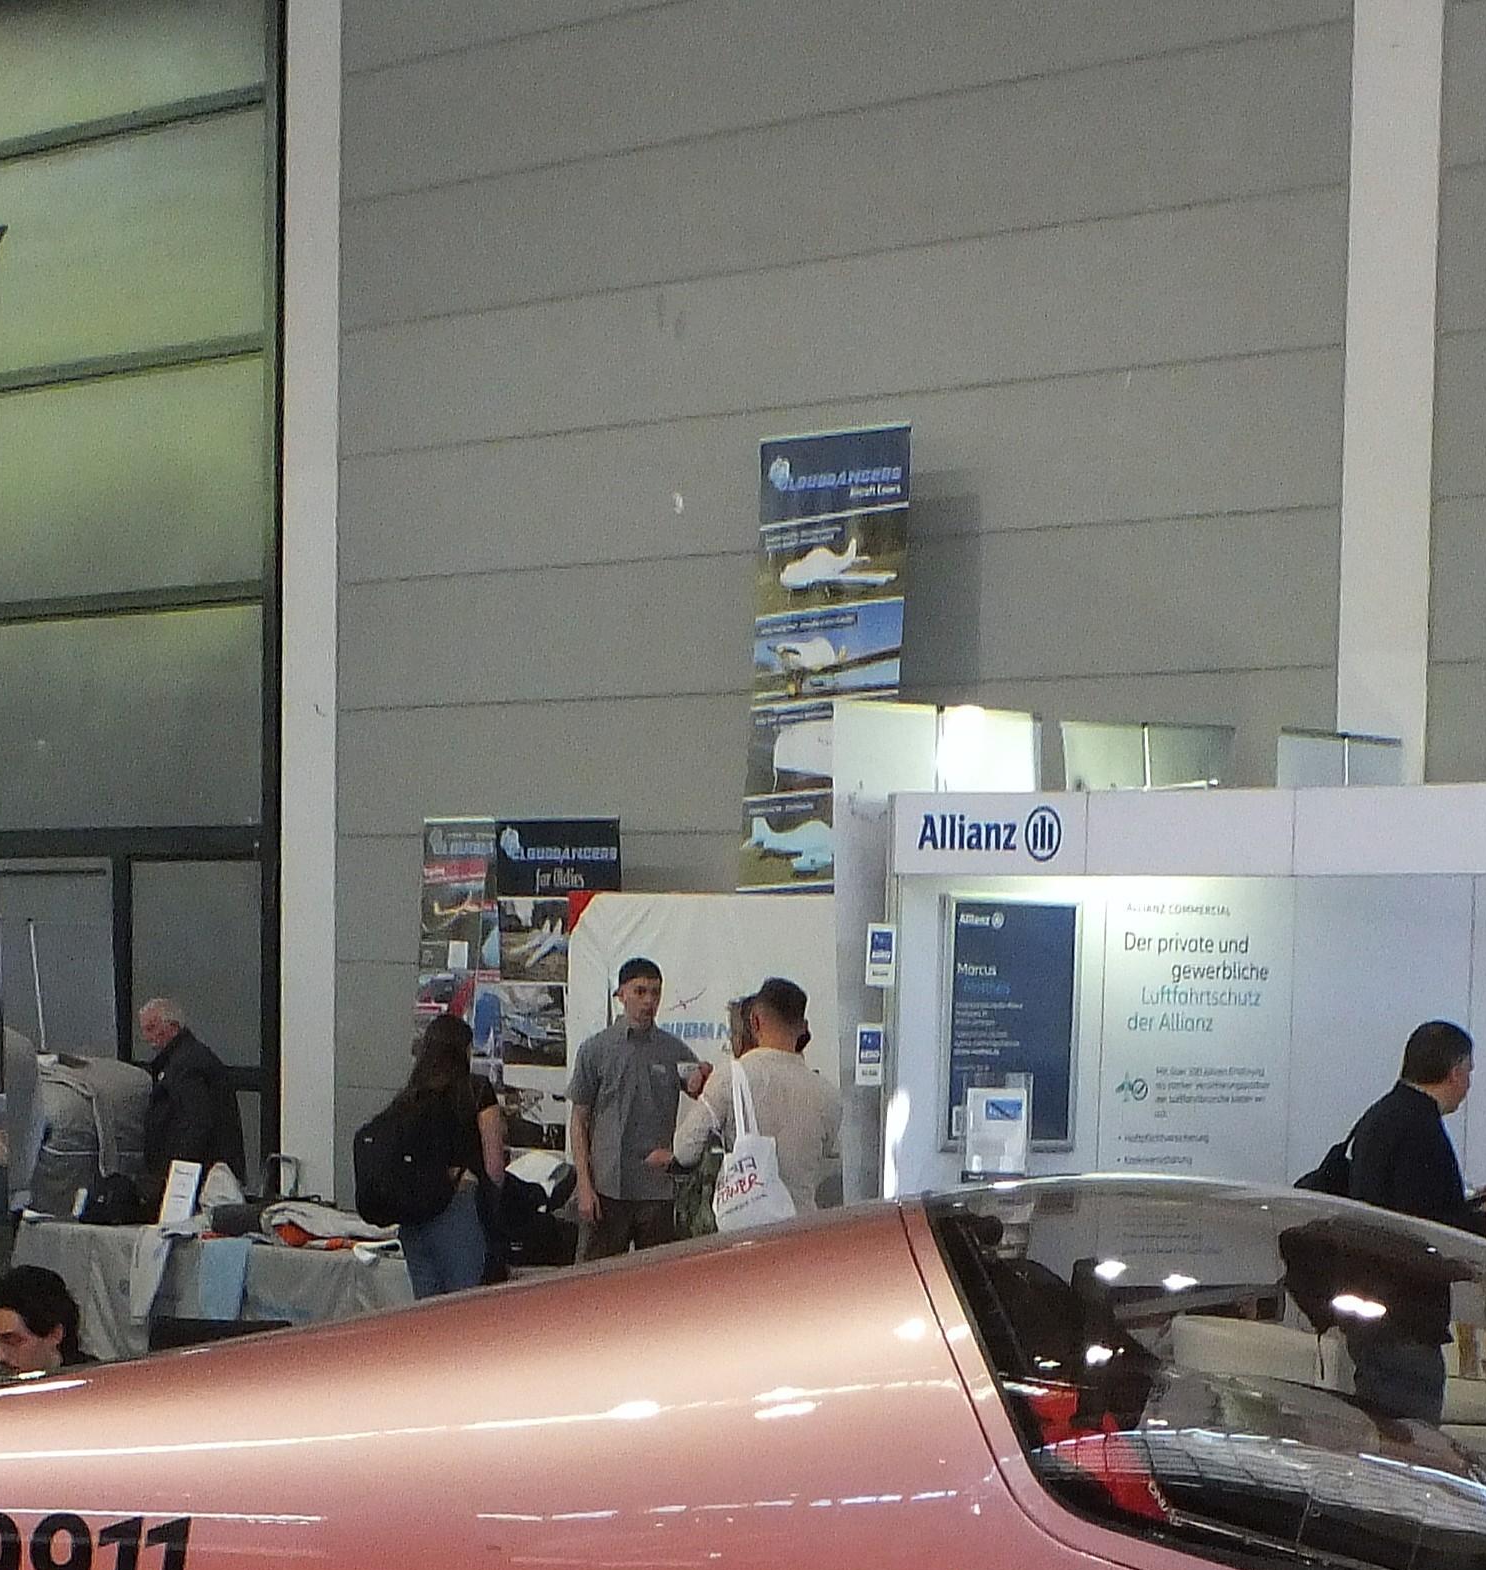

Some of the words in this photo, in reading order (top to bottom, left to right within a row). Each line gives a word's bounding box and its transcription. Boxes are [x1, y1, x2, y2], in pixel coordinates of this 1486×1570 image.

[918, 813, 1017, 851] Allianz
[1124, 931, 1153, 951] Der
[1158, 932, 1215, 955] private
[1218, 936, 1249, 953] und
[957, 962, 997, 976] Marcus
[1171, 960, 1269, 983] gewerbliche
[1141, 985, 1261, 1007] Luftfahrtschutz
[1127, 1014, 1153, 1032] der
[1158, 1012, 1214, 1032] Allianz
